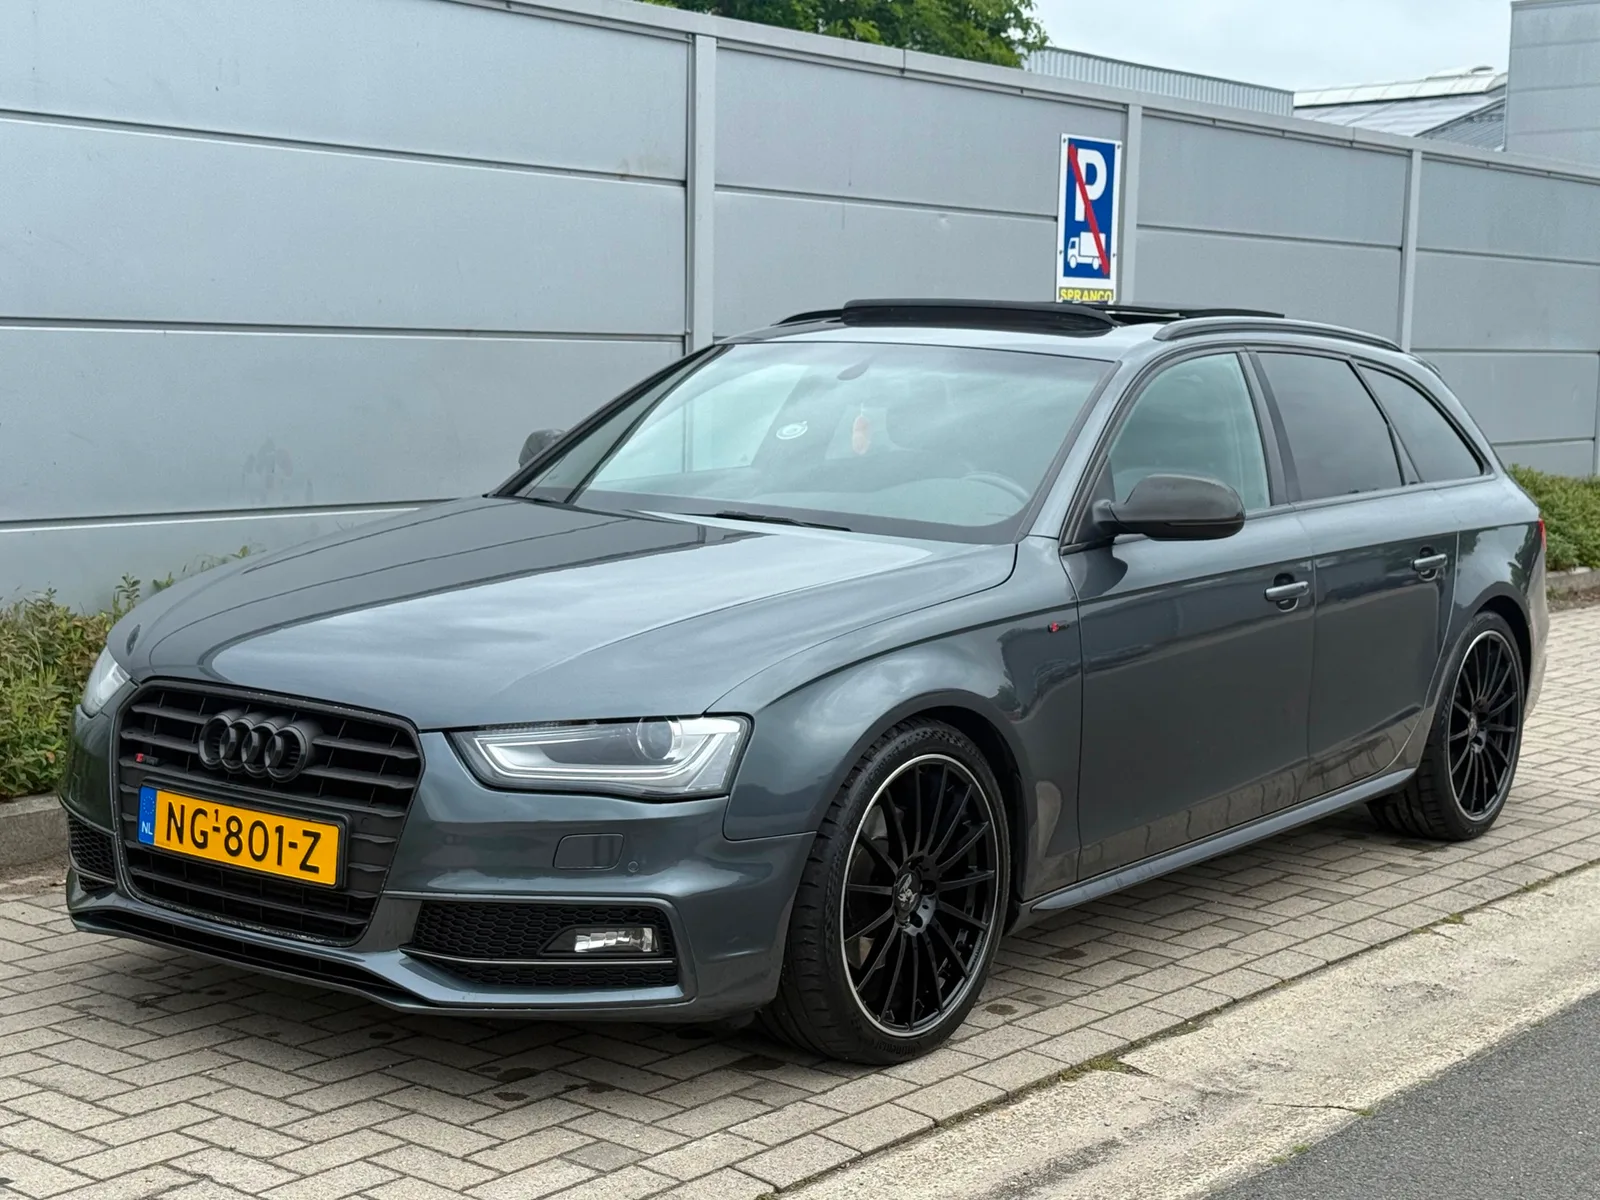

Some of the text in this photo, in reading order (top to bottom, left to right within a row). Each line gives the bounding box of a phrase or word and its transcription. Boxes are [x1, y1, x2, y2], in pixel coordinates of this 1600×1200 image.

[1075, 148, 1107, 222] P
[141, 820, 153, 836] NL
[166, 801, 321, 874] NG-801-Z
